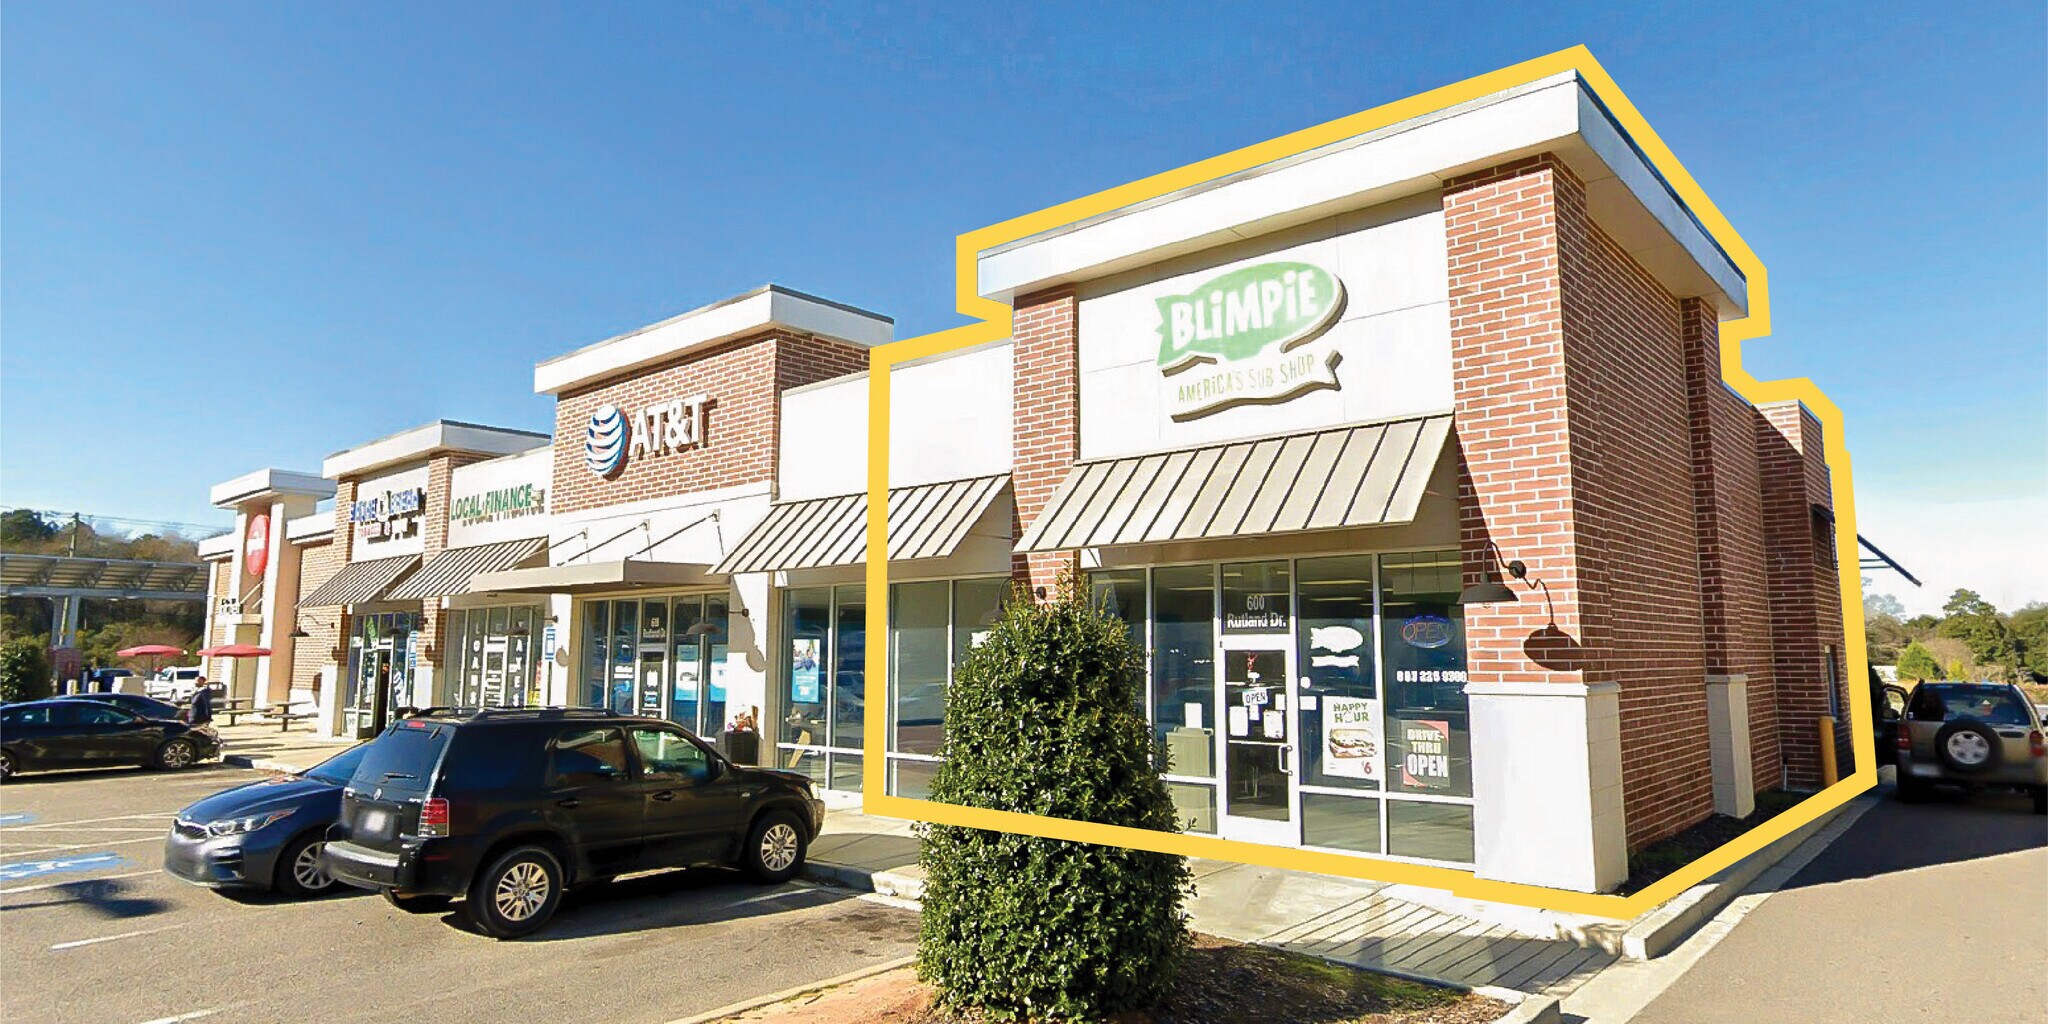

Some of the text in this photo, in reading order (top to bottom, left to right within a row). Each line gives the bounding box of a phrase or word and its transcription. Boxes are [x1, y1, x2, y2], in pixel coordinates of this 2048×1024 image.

[1249, 367, 1274, 388] SUB
[1280, 353, 1315, 384] SHOP
[630, 392, 709, 455] AT&T
[451, 493, 482, 521] LOCAL
[485, 483, 533, 515] FINANCE
[1247, 595, 1265, 611] 600
[1227, 612, 1287, 629] Rutland Dr.
[1402, 621, 1449, 642] OPEN
[1246, 691, 1266, 704] OPEN
[1333, 702, 1368, 712] HAPPY
[1411, 740, 1441, 754] THRU
[1406, 753, 1449, 778] OPEN
